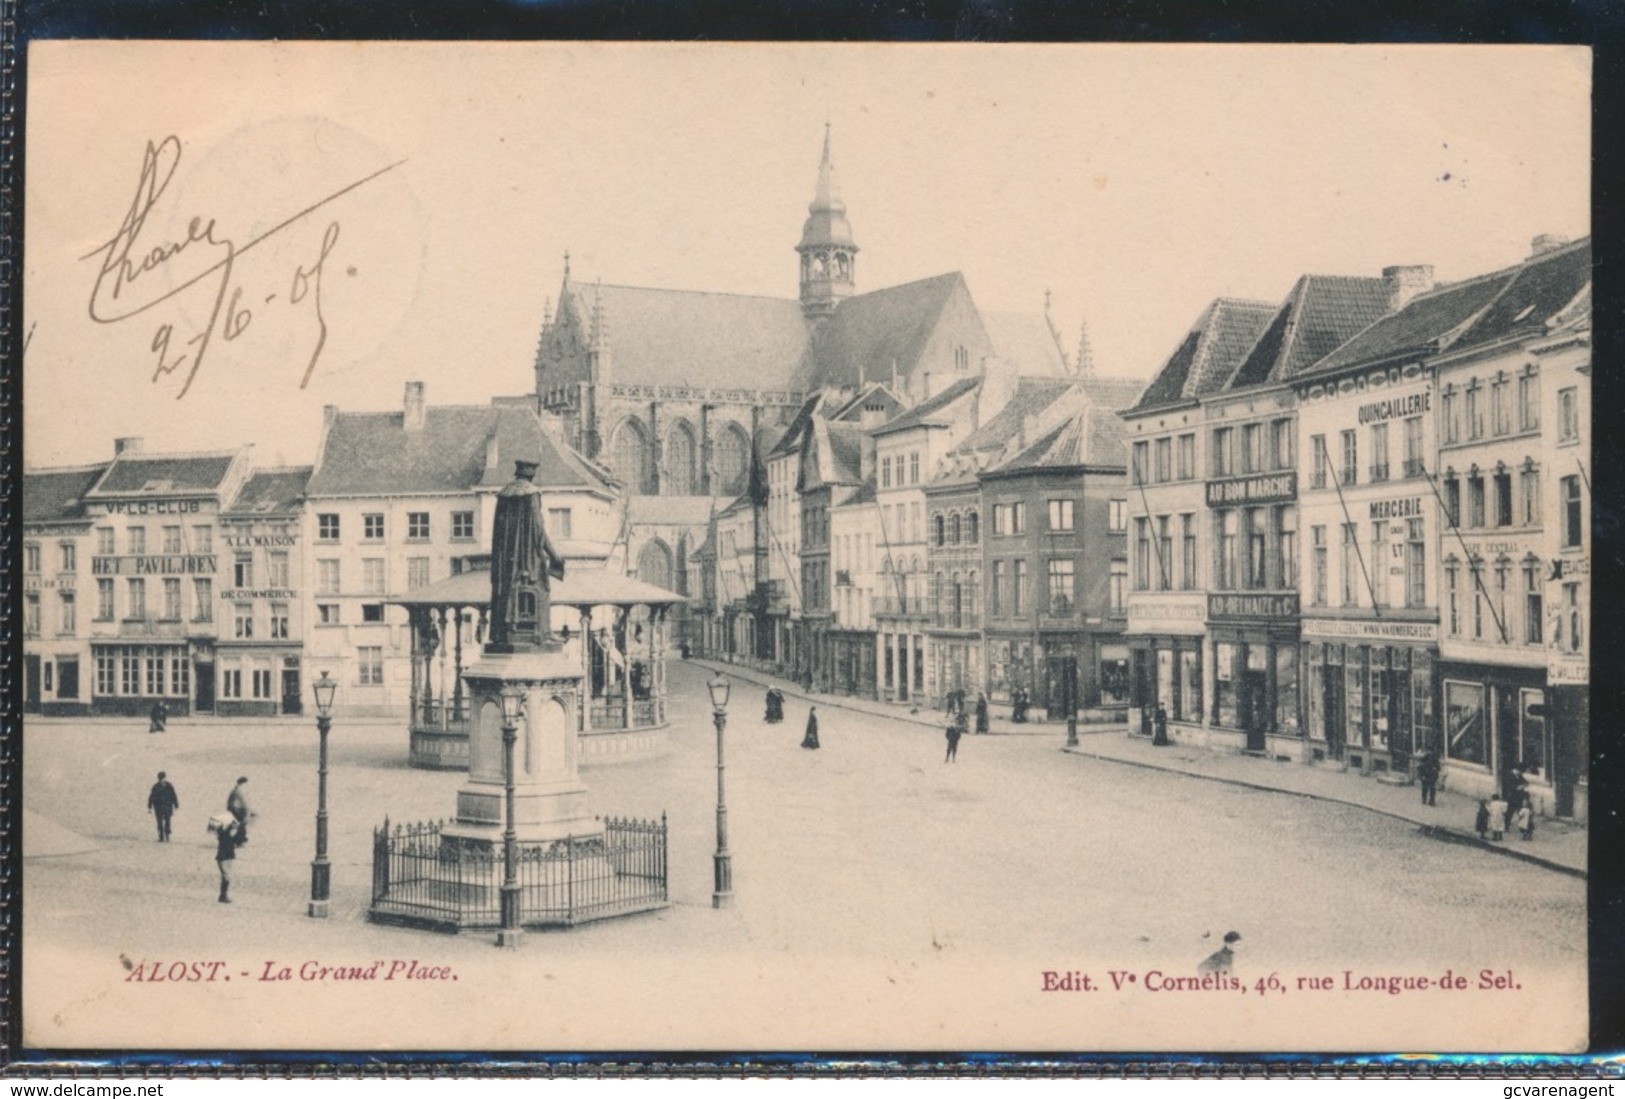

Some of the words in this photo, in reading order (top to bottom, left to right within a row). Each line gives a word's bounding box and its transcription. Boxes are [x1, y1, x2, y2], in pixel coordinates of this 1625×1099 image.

[236, 536, 252, 547] LA
[254, 535, 296, 547] MAISON
[92, 557, 120, 574] HET
[221, 590, 235, 599] DE
[236, 590, 298, 599] COMMERCE
